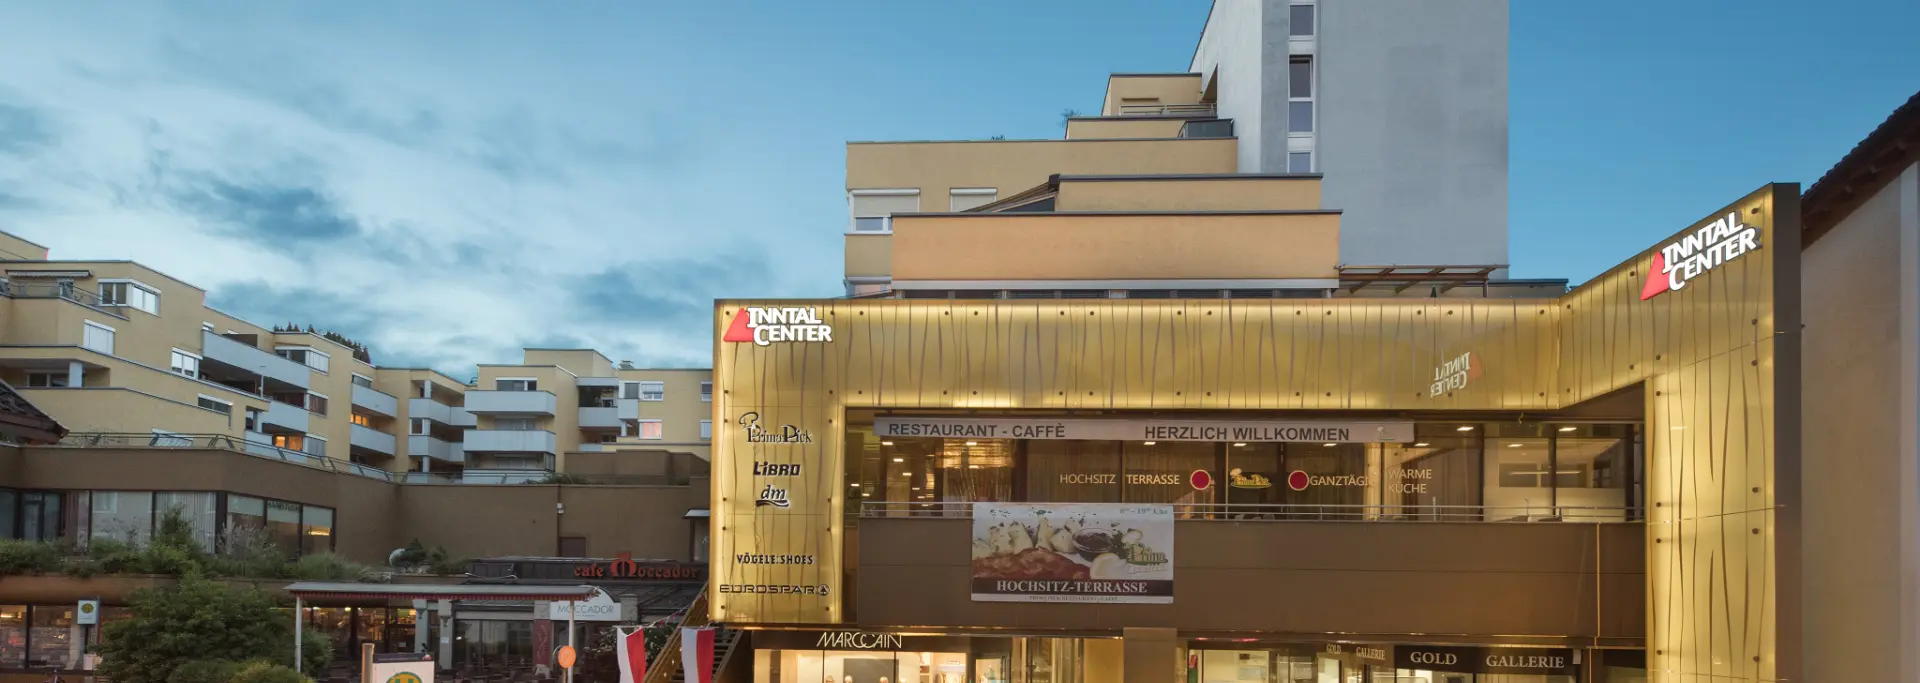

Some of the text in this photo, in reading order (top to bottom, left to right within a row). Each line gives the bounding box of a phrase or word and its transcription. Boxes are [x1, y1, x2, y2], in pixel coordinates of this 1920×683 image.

[1662, 211, 1744, 273] INNTAL
[1668, 227, 1757, 291] CENTER
[747, 307, 822, 327] INNTAL
[753, 324, 833, 346] CENTER
[888, 423, 998, 437] RESTAURANT
[1012, 422, 1065, 438] CAFFÈ
[1145, 426, 1350, 441] HERZLICH WILLKOMMEN
[1059, 473, 1180, 485] HOCHSITZ TERRASSE
[760, 485, 786, 500] dm
[719, 584, 815, 594] EUROSPAR
[996, 580, 1148, 594] HOCHSITZ-TERRASSE
[1410, 651, 1565, 669] GOLD GALLERIE
